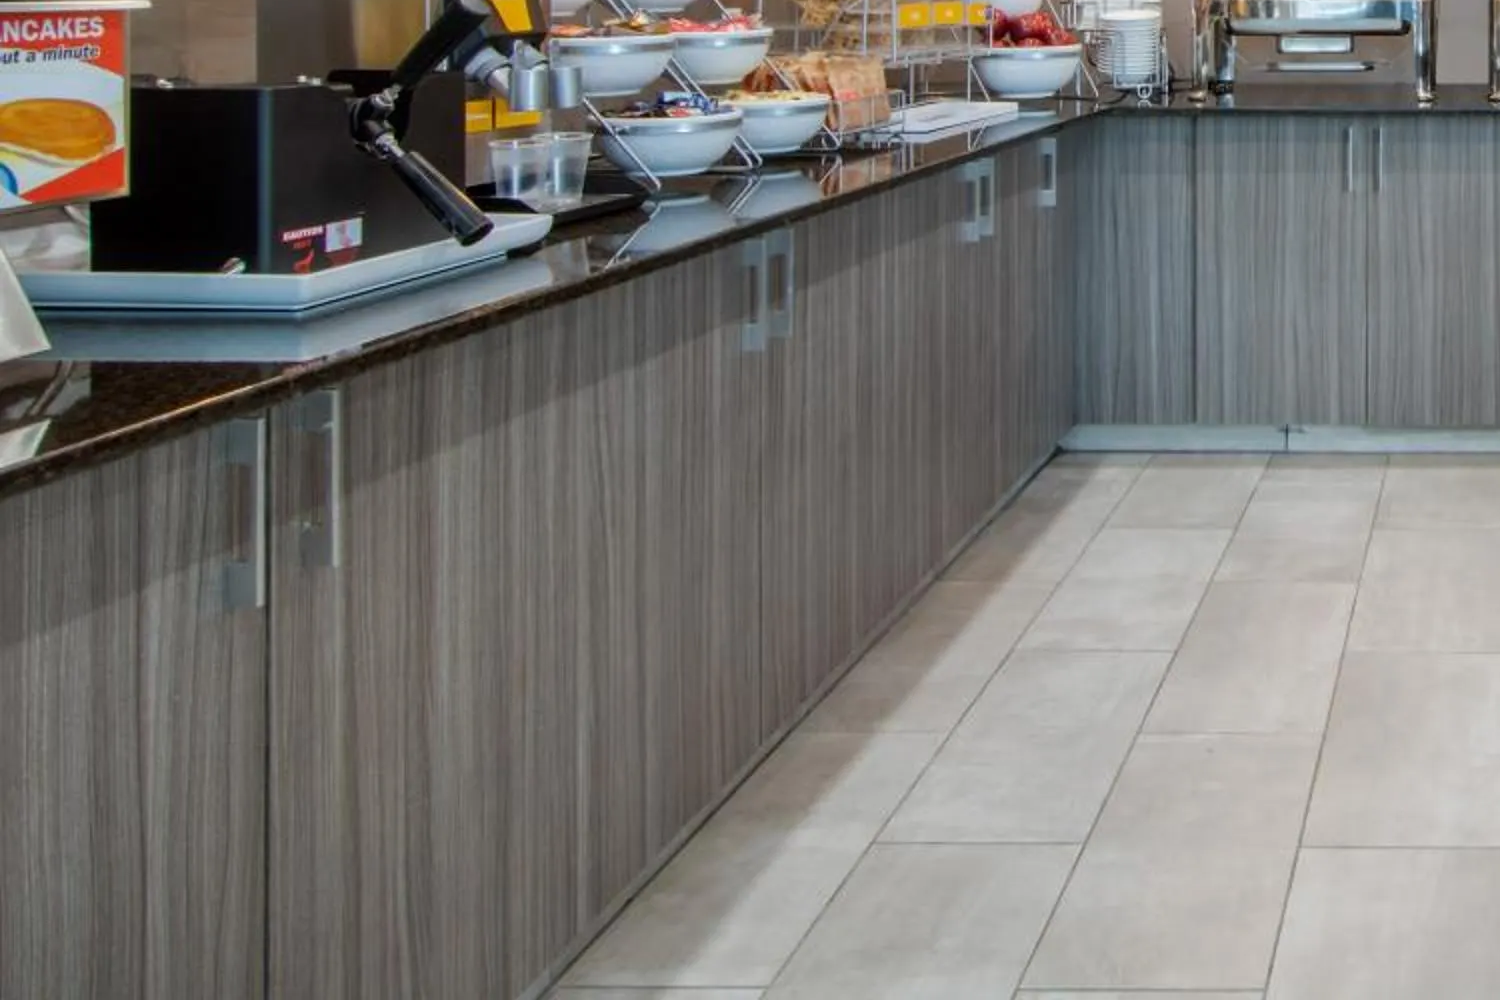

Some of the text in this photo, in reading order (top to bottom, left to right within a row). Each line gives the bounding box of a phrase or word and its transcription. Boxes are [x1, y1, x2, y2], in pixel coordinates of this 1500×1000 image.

[0, 16, 105, 43] NCAKES
[0, 44, 100, 65] ut a minute
